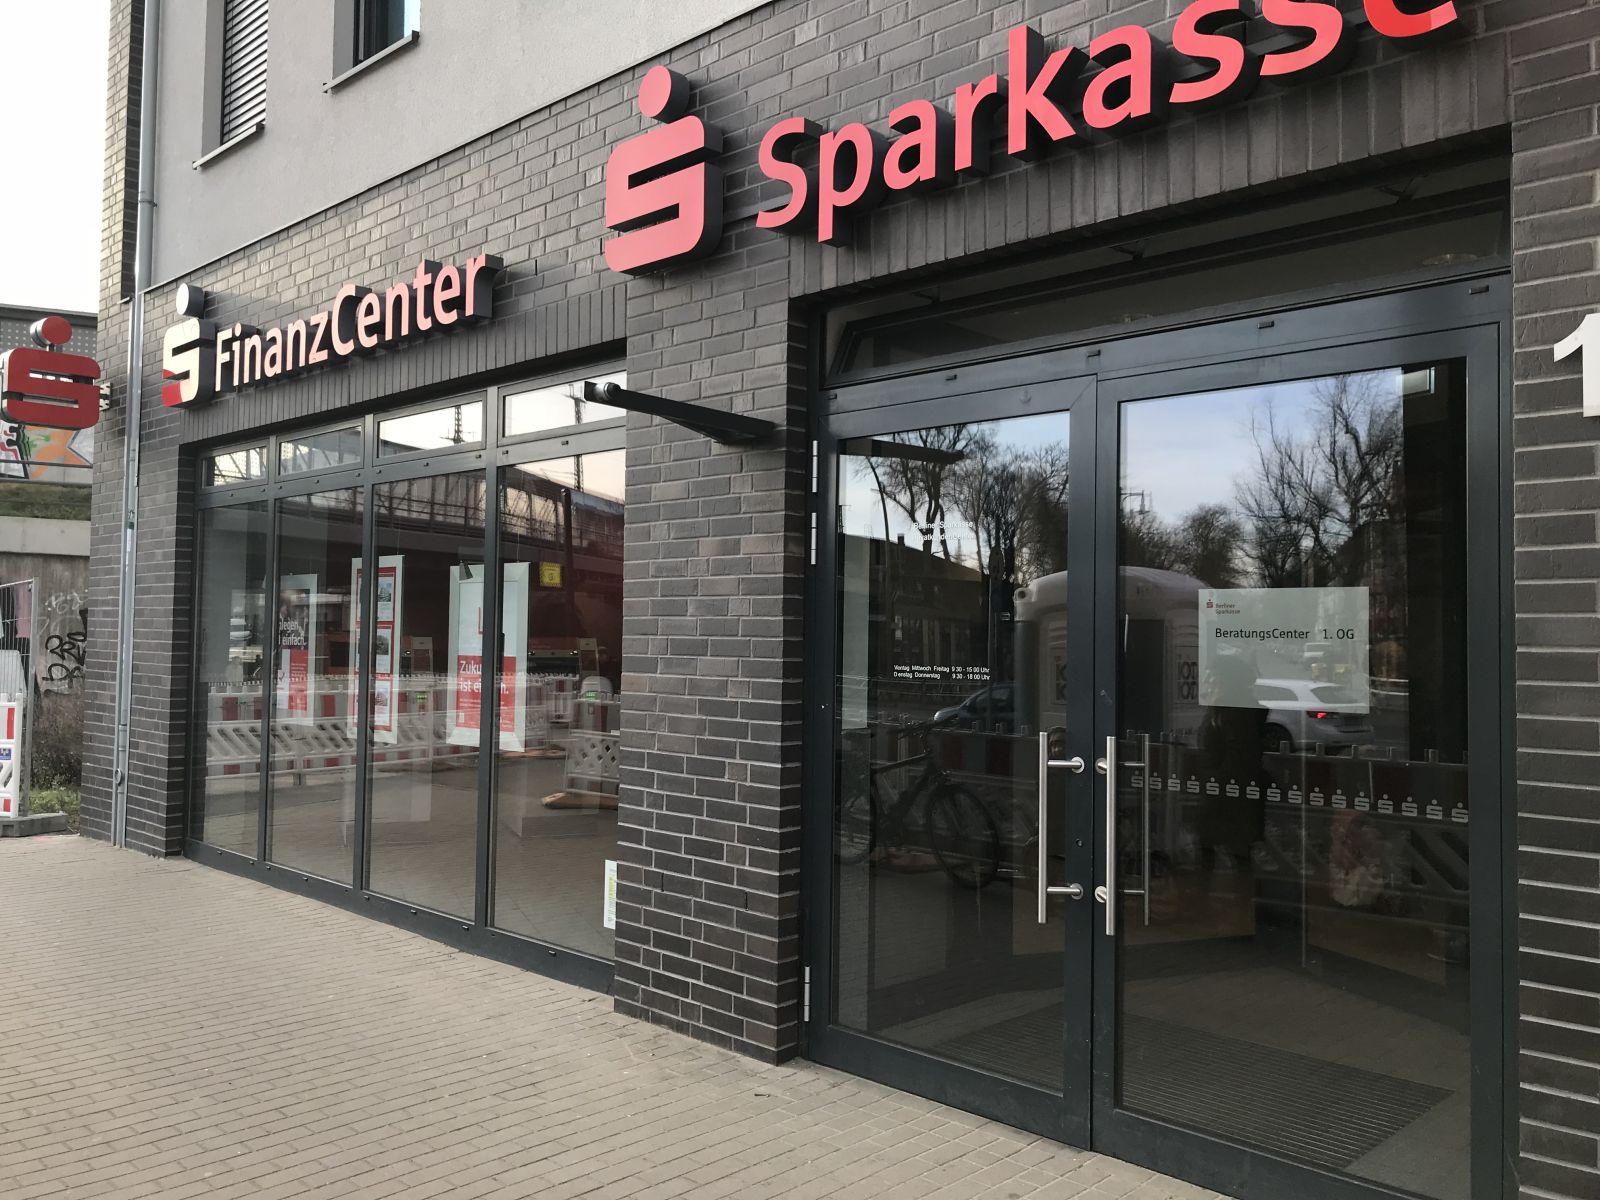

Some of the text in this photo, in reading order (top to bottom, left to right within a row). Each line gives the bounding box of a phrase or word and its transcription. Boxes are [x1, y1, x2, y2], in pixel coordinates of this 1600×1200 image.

[215, 254, 486, 392] FinanzCenter
[1215, 628, 1355, 641] BeratungsCenter 1. OG
[933, 665, 950, 673] Freitag
[459, 678, 472, 692] ist
